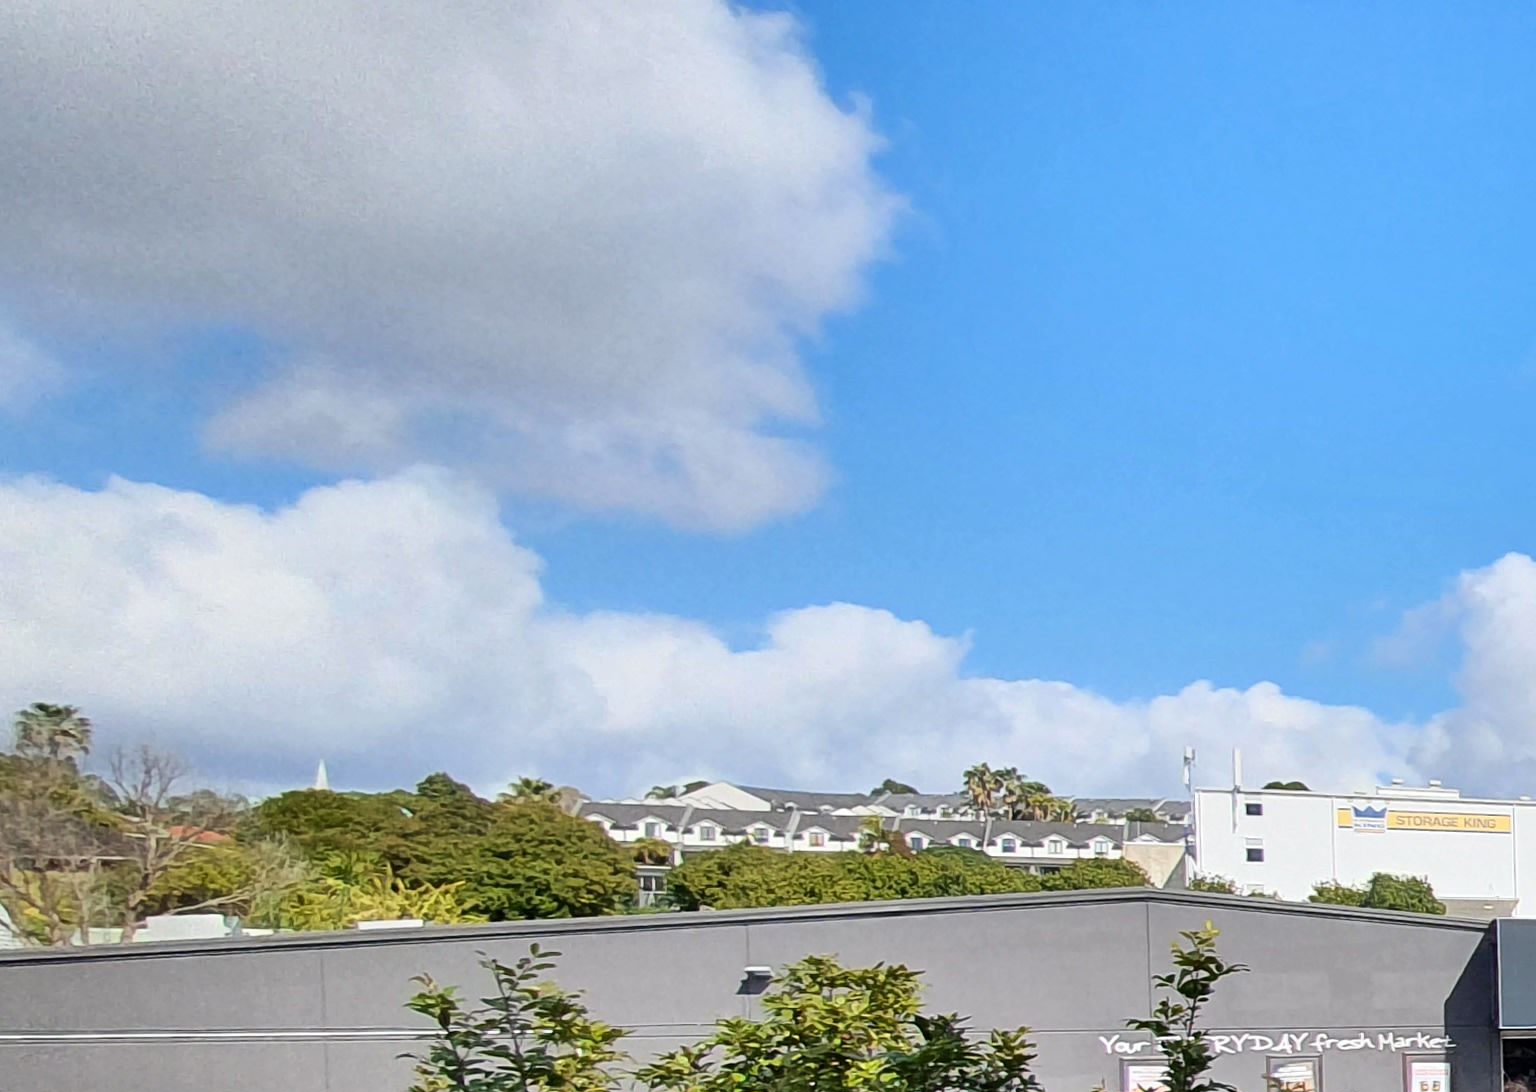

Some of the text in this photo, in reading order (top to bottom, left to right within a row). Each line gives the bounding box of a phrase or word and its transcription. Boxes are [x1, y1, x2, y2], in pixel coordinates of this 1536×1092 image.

[1396, 815, 1459, 828] STORAGE
[1464, 818, 1497, 829] KING
[1098, 1034, 1150, 1055] Your
[1311, 1034, 1373, 1051] fresh
[1378, 1032, 1456, 1052] Market
